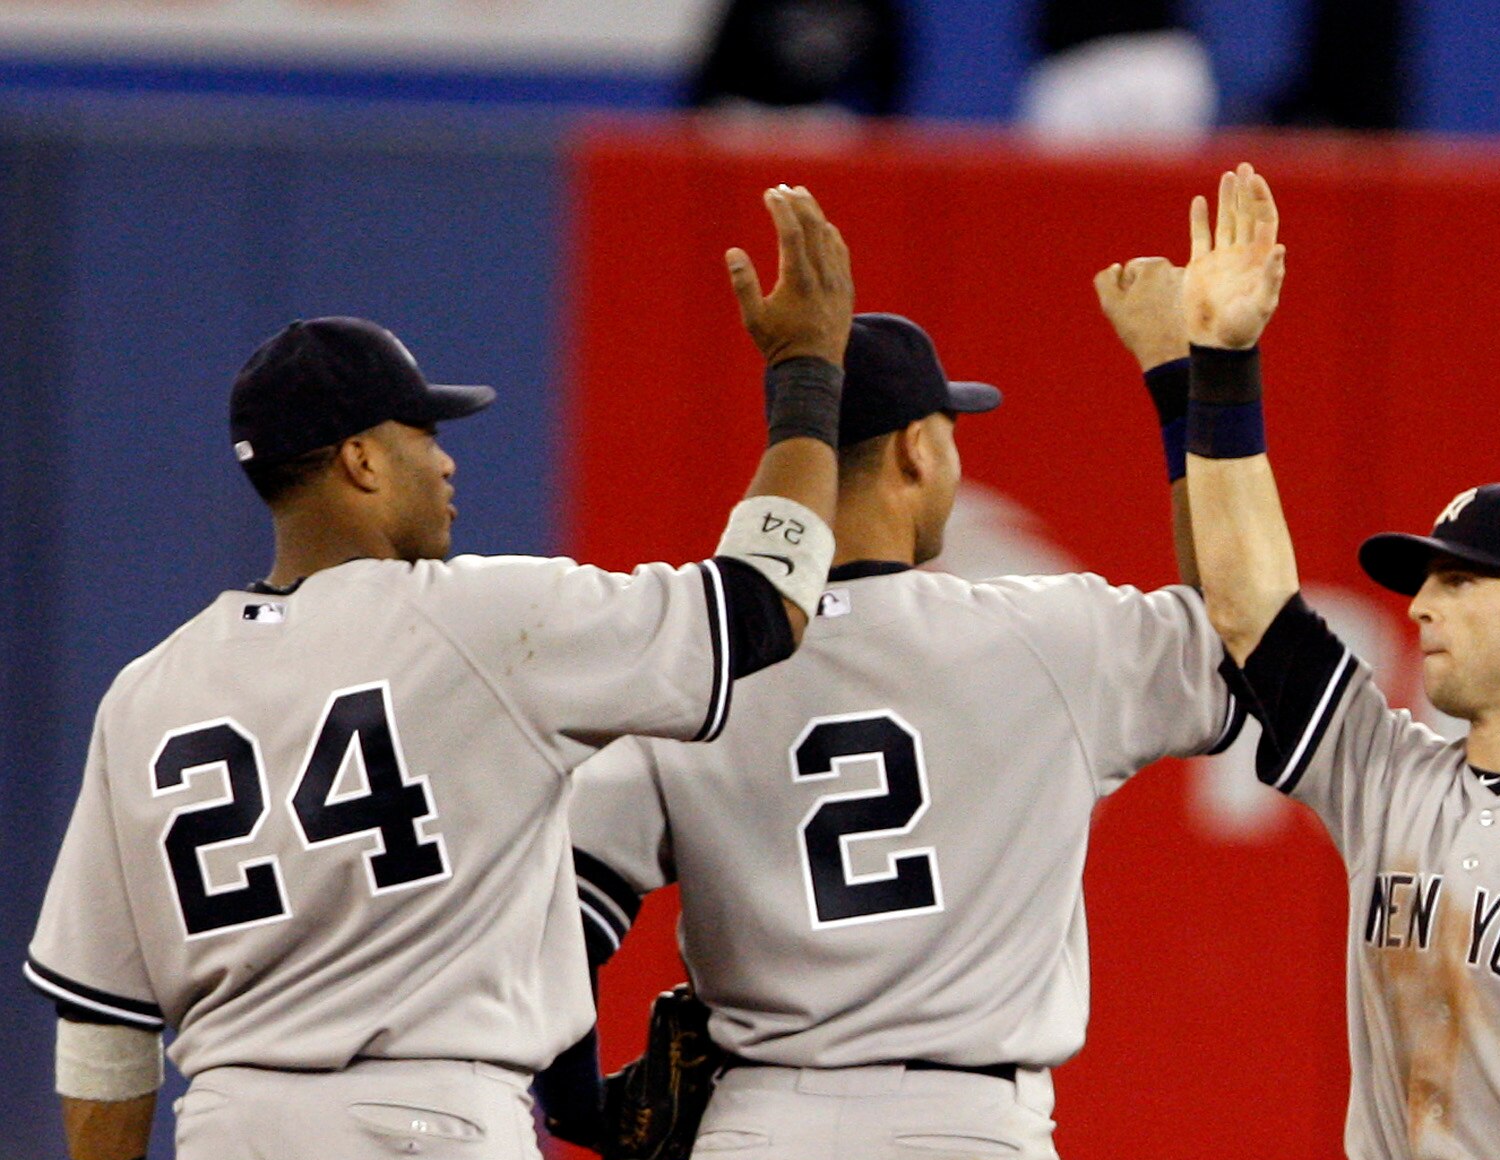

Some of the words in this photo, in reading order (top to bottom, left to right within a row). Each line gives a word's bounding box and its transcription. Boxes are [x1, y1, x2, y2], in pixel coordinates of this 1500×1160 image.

[762, 512, 805, 545] 24
[149, 679, 453, 941] 24
[788, 707, 945, 931] 2
